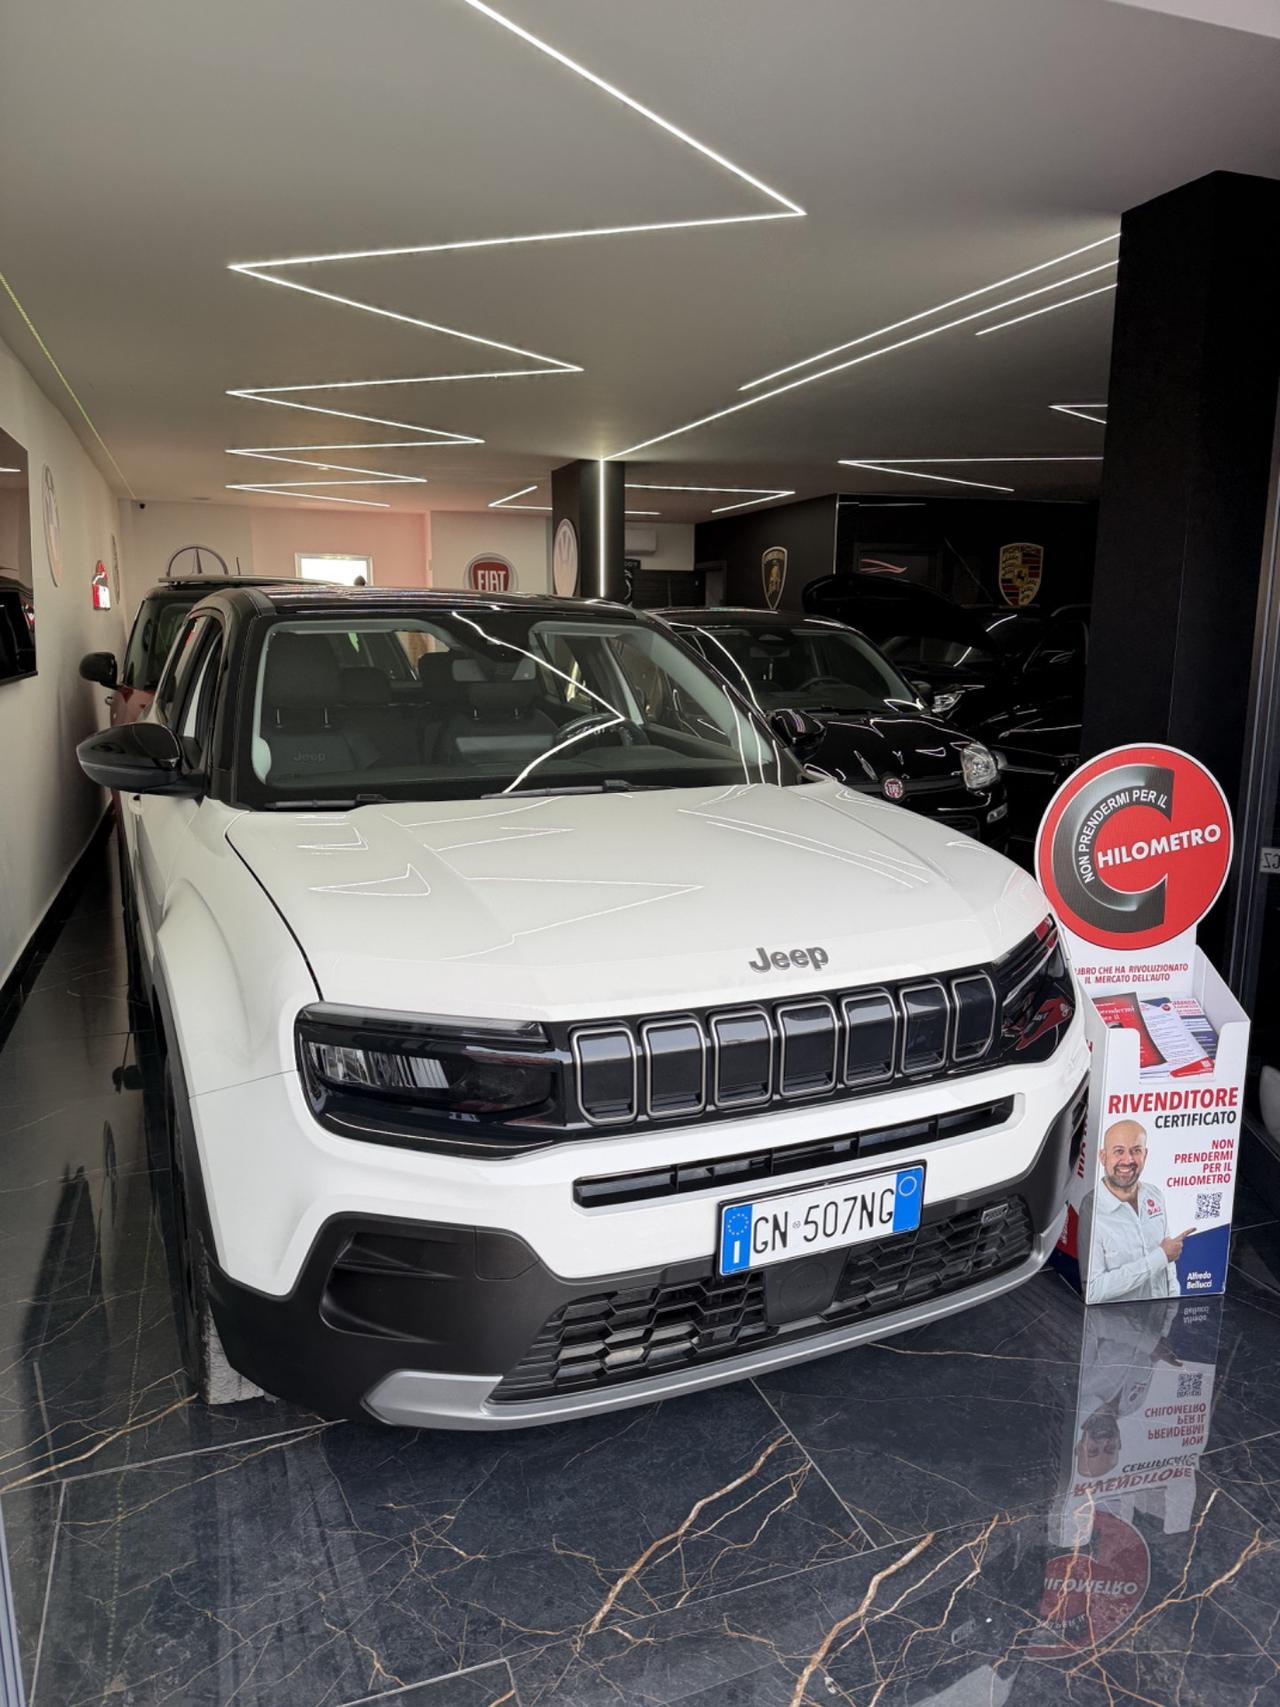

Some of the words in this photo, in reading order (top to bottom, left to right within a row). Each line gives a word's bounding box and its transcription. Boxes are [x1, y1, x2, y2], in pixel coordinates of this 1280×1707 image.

[477, 570, 506, 592] FIAT
[1132, 789, 1156, 803] PER
[1157, 793, 1168, 808] IL
[1079, 792, 1130, 852] PRENDERMI
[1097, 824, 1221, 869] HILOMETRO
[1079, 856, 1095, 883] NON
[748, 947, 829, 973] Jeep
[1099, 966, 1113, 975] CHE
[1115, 965, 1126, 974] HA
[1129, 963, 1189, 973] RIVOLUZIONATO
[1085, 976, 1092, 984] IL
[1095, 974, 1130, 984] MERCATO
[1132, 973, 1170, 982] DELL'AUTO
[1108, 1087, 1239, 1114] RIVENDITORE
[1155, 1110, 1237, 1129] CERTIFICATO
[1211, 1139, 1234, 1149] NON
[1174, 1150, 1233, 1164] PRENDERMI
[1202, 1163, 1221, 1173] PER
[1224, 1162, 1232, 1172] IL
[1166, 1173, 1231, 1187] CHILOMETRO
[753, 1211, 789, 1254] GN
[803, 1188, 895, 1243] 507NG
[1187, 1271, 1212, 1281] Alfredo
[1186, 1280, 1212, 1289] Bellucci
